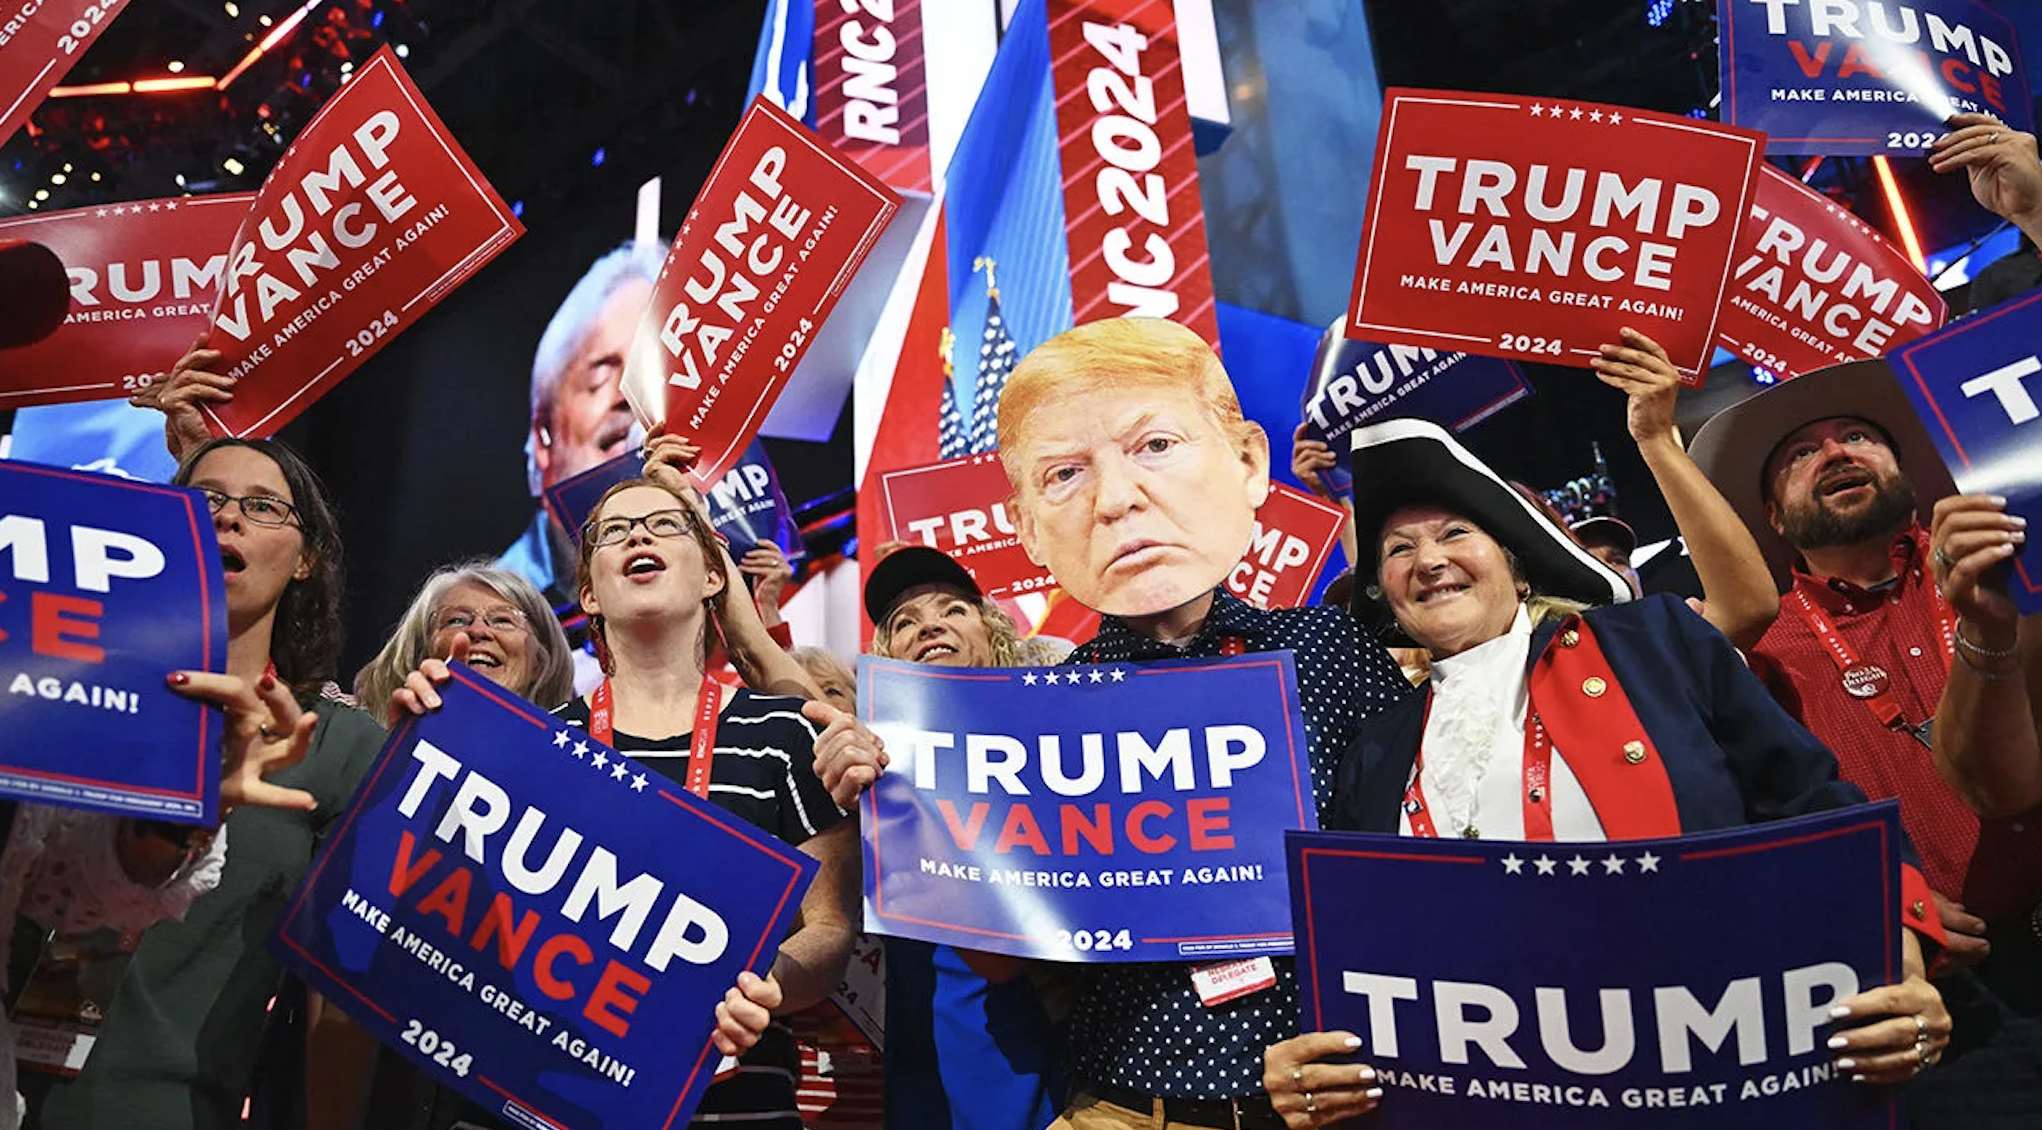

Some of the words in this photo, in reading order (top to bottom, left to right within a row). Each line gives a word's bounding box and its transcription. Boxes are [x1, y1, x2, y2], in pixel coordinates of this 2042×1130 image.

[0, 0, 44, 46] ERIC
[1751, 0, 2014, 77] TRUMP
[1771, 88, 1825, 102] MAKE
[1832, 89, 1919, 103] AMERICA
[1788, 40, 2006, 112] VACE
[227, 110, 400, 298] RUMP
[1405, 154, 1720, 240] TRUMP
[66, 254, 228, 306] RUM
[216, 169, 418, 342] VANCE
[660, 146, 787, 357] RUMP
[1428, 218, 1678, 291] VANCE
[63, 308, 146, 325] AMERICA
[153, 303, 211, 321] GREAT
[228, 343, 273, 383] MAKE
[273, 290, 343, 347] AMERICA
[342, 248, 393, 291] GREAT
[395, 203, 450, 252] AGAIN!
[669, 194, 812, 390] VANCE
[689, 388, 721, 430] MAKE
[718, 317, 766, 385] AMERICA
[763, 264, 799, 314] GREAT
[798, 204, 839, 262] AGAIN!
[1400, 274, 1451, 292] MAKE
[1456, 281, 1542, 301] AMERICA
[1548, 290, 1613, 309] GREAT
[1618, 299, 1684, 321] AGAIN!
[345, 310, 400, 357] 2024
[774, 318, 814, 372] 2024
[1499, 333, 1564, 355] 2024
[1731, 295, 1788, 331] AMERICA
[1790, 326, 1834, 355] GREAT
[1306, 344, 1438, 430] TRUM
[1742, 342, 1788, 373] 2024
[1354, 394, 1397, 423] AMERICA
[1397, 370, 1430, 397] GREAT
[908, 503, 1016, 549] TRU
[1011, 575, 1056, 592] 2024
[9, 672, 139, 714] AGAIN!
[903, 724, 1268, 797] TRUMP
[397, 739, 729, 973] TRUMP
[935, 797, 1236, 857] VANCE
[920, 858, 982, 881] MAKE
[989, 868, 1092, 888] AMERICA
[1098, 869, 1174, 888] GREAT
[1182, 864, 1264, 884] AGAIN!
[388, 830, 652, 1038] VANCE
[1056, 929, 1134, 951] 2024
[341, 888, 392, 935] MAKE
[390, 926, 475, 993] AMERICA
[479, 983, 551, 1036] GREAT
[552, 1030, 636, 1088] AGAIN!
[1342, 961, 1860, 1075] TRUMP
[401, 1018, 474, 1078] 2024
[1377, 1069, 1456, 1095] MAKE
[1467, 1079, 1610, 1107] AMERICA
[1621, 1084, 1727, 1109] GREAT
[1740, 1060, 1840, 1100] AGAIN!
